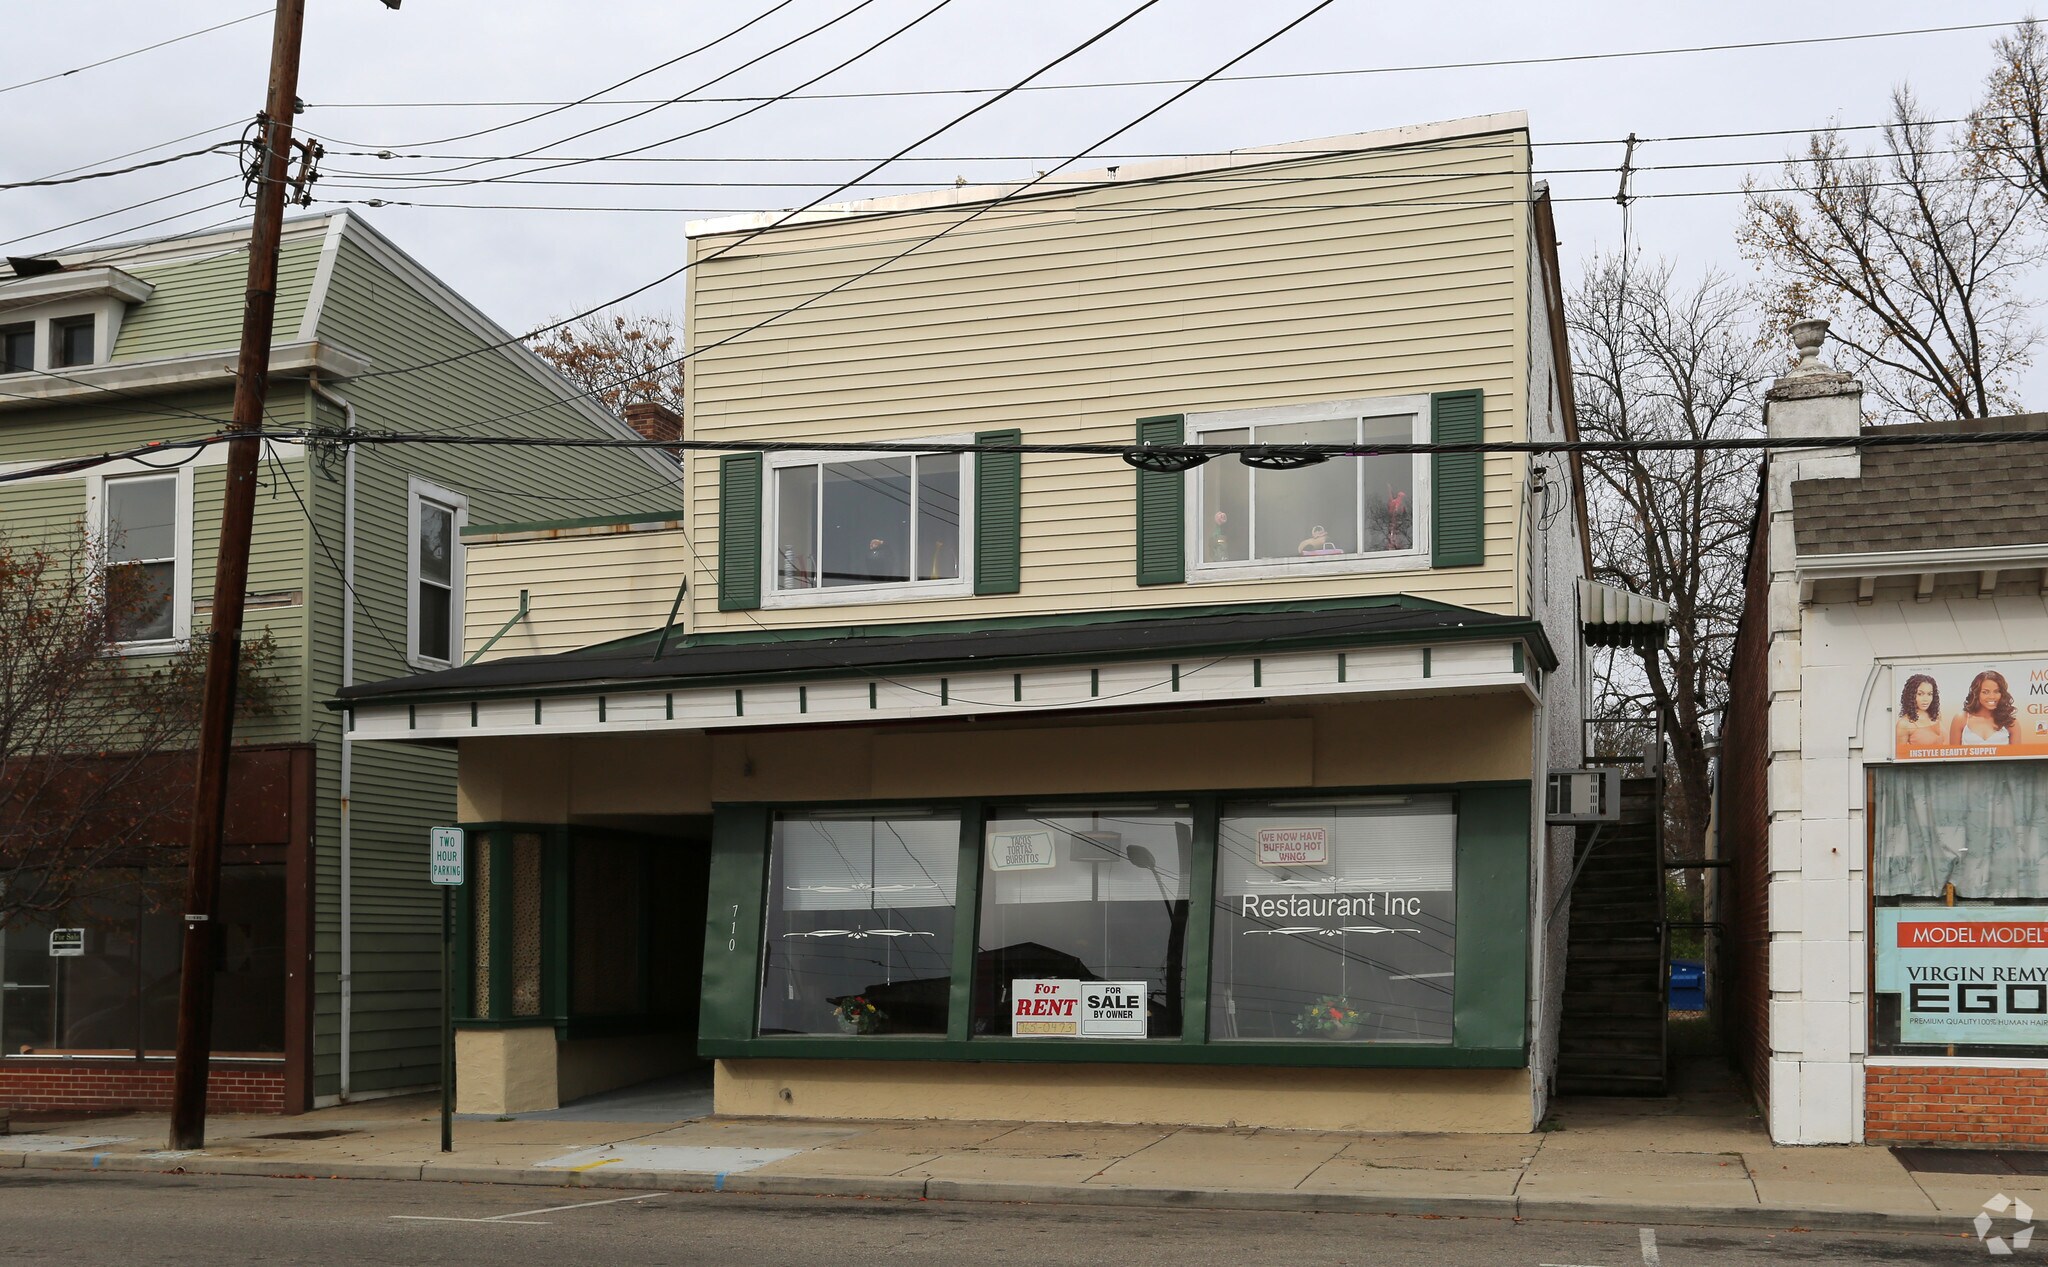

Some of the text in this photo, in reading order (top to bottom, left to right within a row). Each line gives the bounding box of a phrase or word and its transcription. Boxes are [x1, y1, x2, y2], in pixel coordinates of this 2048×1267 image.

[1909, 747, 1997, 757] INSTYLE BEAUTY SUPPLY
[440, 836, 455, 847] TWO
[1011, 835, 1032, 847] TACOS
[1261, 831, 1323, 842] WE NOW HAVE
[1007, 844, 1033, 856] TORTAS
[1263, 841, 1322, 852] BUFFALO HOT
[437, 850, 457, 861] HOUR
[1005, 853, 1039, 865] BURRITOS
[1279, 852, 1306, 861] WINGS
[433, 864, 461, 876] PARKING
[1242, 891, 1421, 918] Restaurant Inc
[728, 904, 739, 952] 710
[1912, 927, 1977, 943] MODEL
[1906, 966, 2048, 982] VIRGIN REMY
[1034, 983, 1060, 994] For
[1105, 986, 1121, 994] FOR
[1087, 995, 1140, 1009] SALE
[1910, 983, 2047, 1014] EGO
[1015, 998, 1078, 1016] RENT
[1093, 1010, 1133, 1019] BY OWNER
[1946, 1018, 1977, 1026] QUALITY
